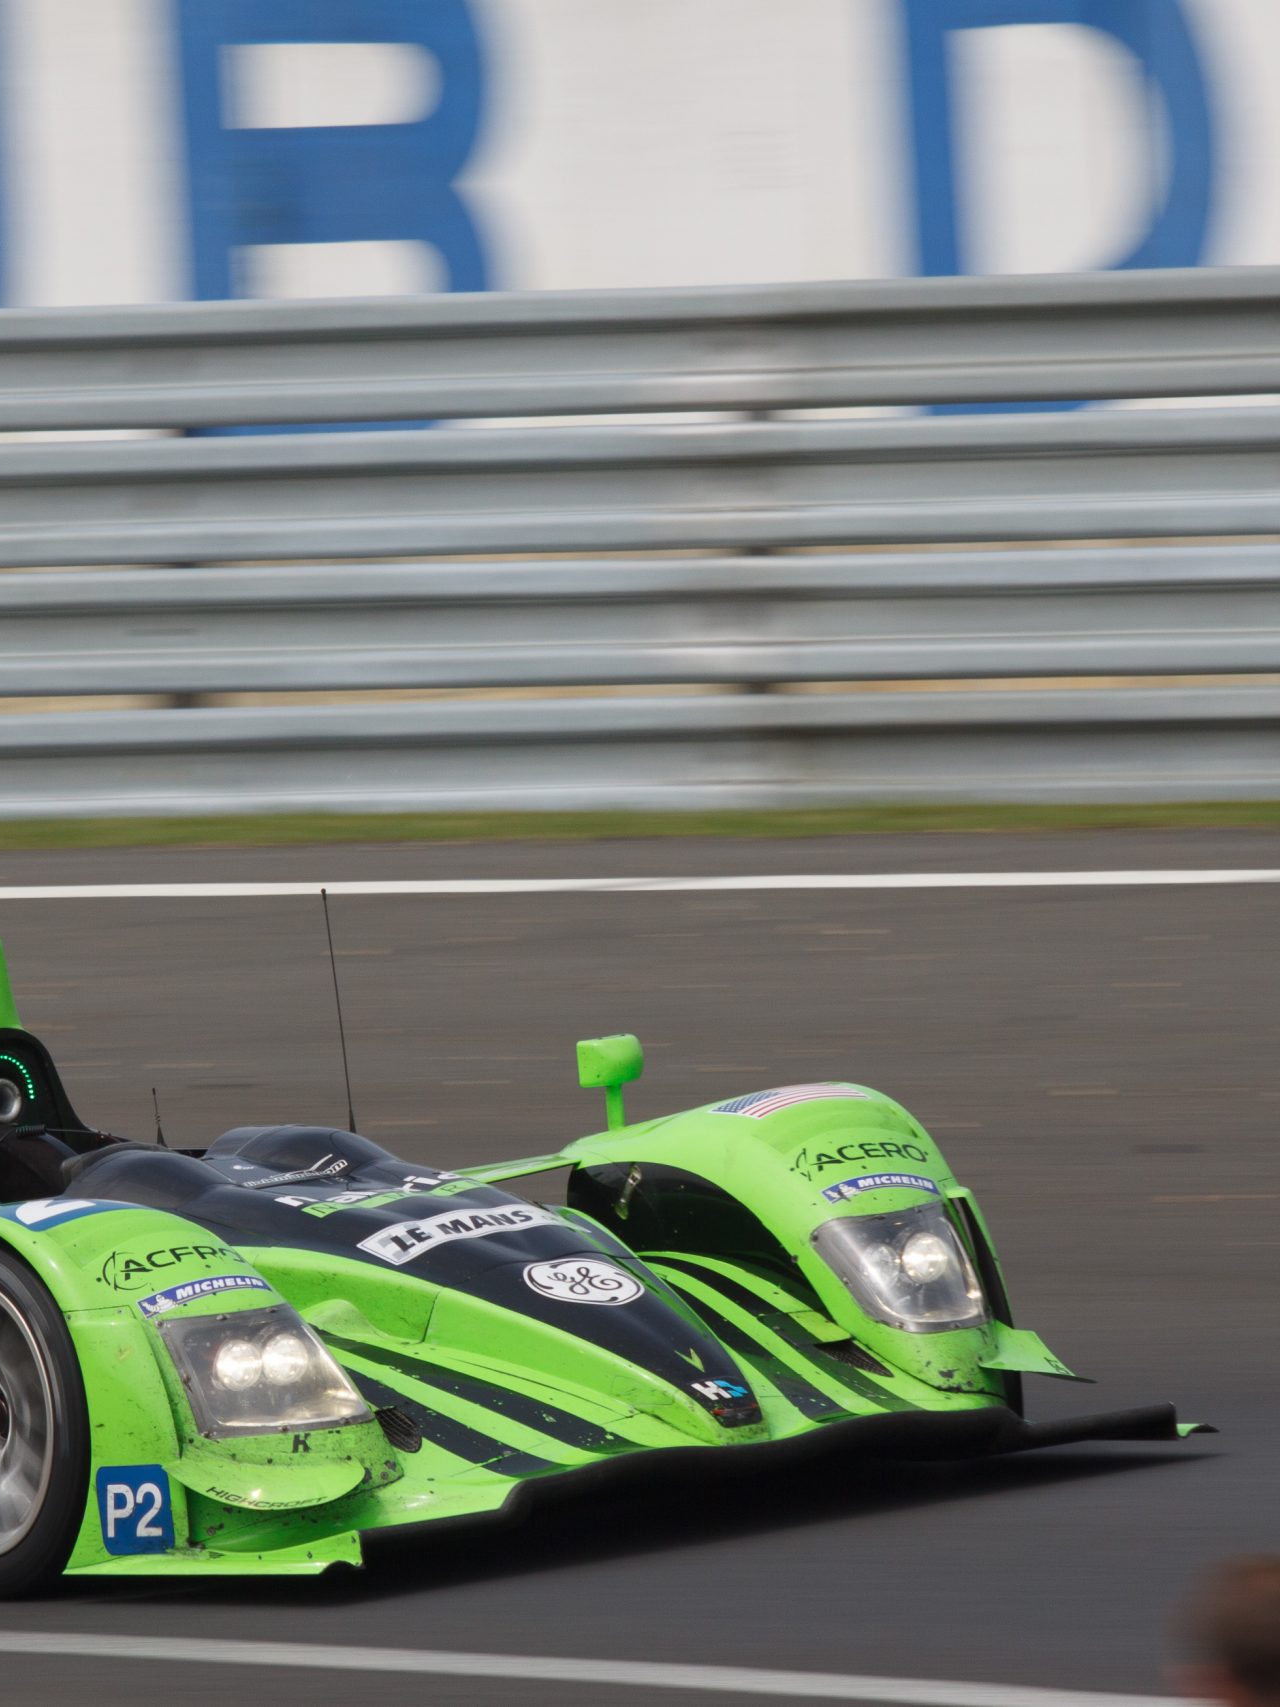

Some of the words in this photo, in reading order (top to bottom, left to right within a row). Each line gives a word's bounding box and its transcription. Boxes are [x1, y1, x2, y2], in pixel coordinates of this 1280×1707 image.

[811, 1142, 929, 1171] ACERO
[857, 1175, 934, 1190] MICHELIN
[390, 1227, 433, 1252] LE
[435, 1210, 533, 1235] MANS
[175, 1276, 264, 1300] MICHELIN
[106, 1483, 162, 1538] P2
